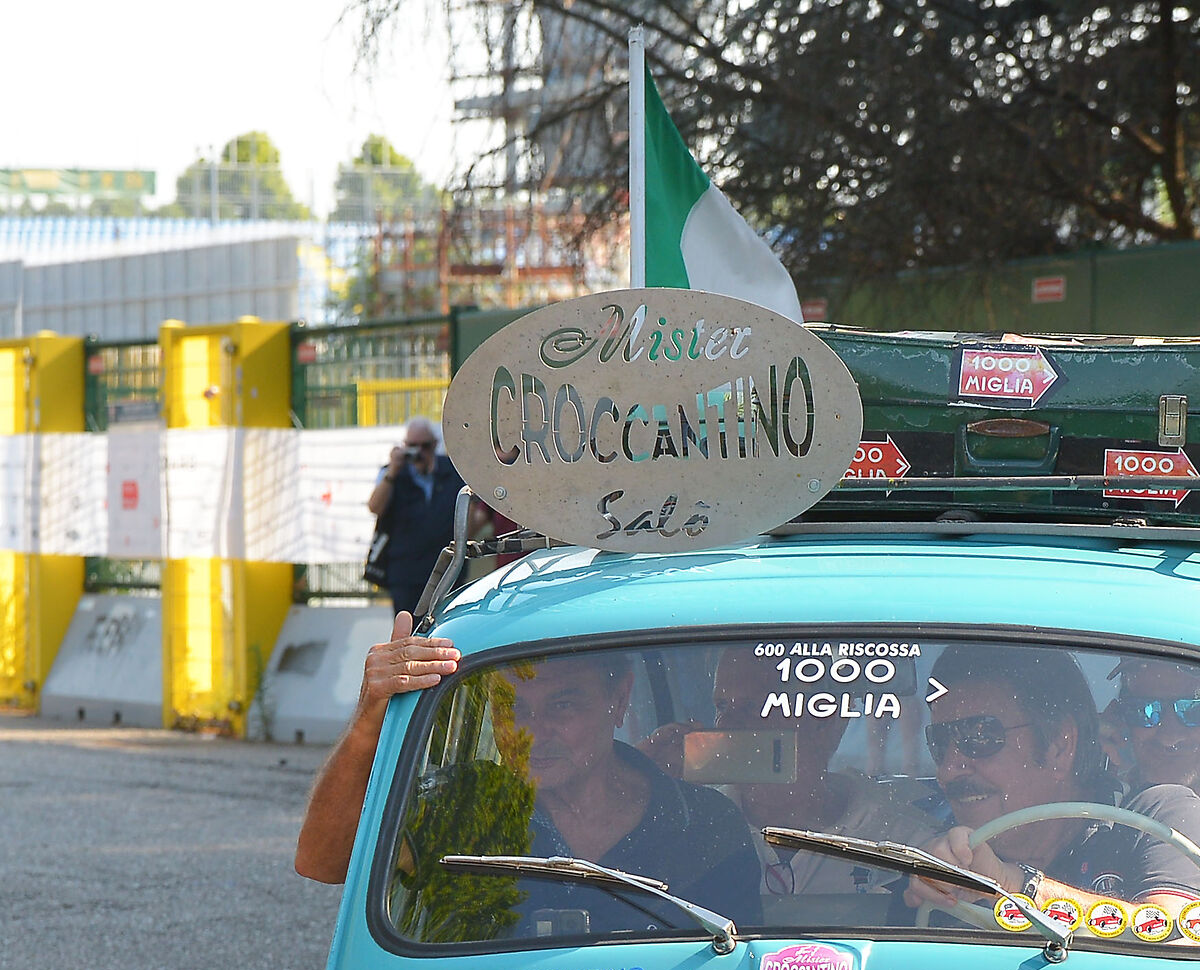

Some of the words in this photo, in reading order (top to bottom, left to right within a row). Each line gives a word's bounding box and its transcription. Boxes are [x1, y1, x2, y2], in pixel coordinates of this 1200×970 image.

[538, 304, 753, 369] Mister
[972, 355, 1030, 373] 1000
[965, 376, 1034, 394] MIGLIA
[488, 356, 816, 467] CROCCANTINO
[1115, 456, 1174, 473] 1000
[754, 643, 785, 657] 600
[789, 643, 833, 656] ALLA
[838, 643, 921, 657] RISCOSSA
[776, 658, 896, 683] 1000
[760, 692, 901, 719] MIGLIA
